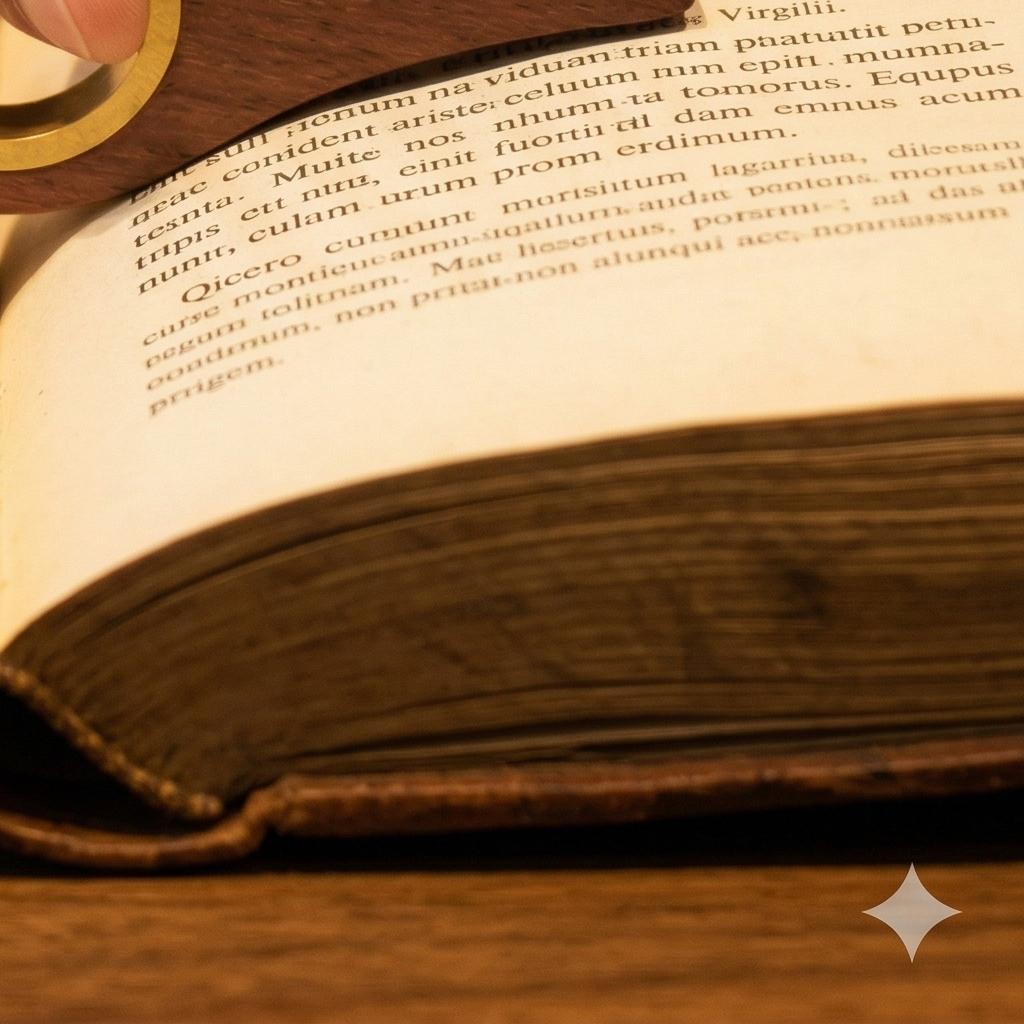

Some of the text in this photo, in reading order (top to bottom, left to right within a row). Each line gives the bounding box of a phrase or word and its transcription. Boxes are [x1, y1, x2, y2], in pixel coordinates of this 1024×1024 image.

[718, 0, 846, 22] Virgilii.
[429, 80, 474, 101] na
[674, 106, 753, 124] dam
[404, 131, 466, 153] nos
[249, 201, 360, 242] culam
